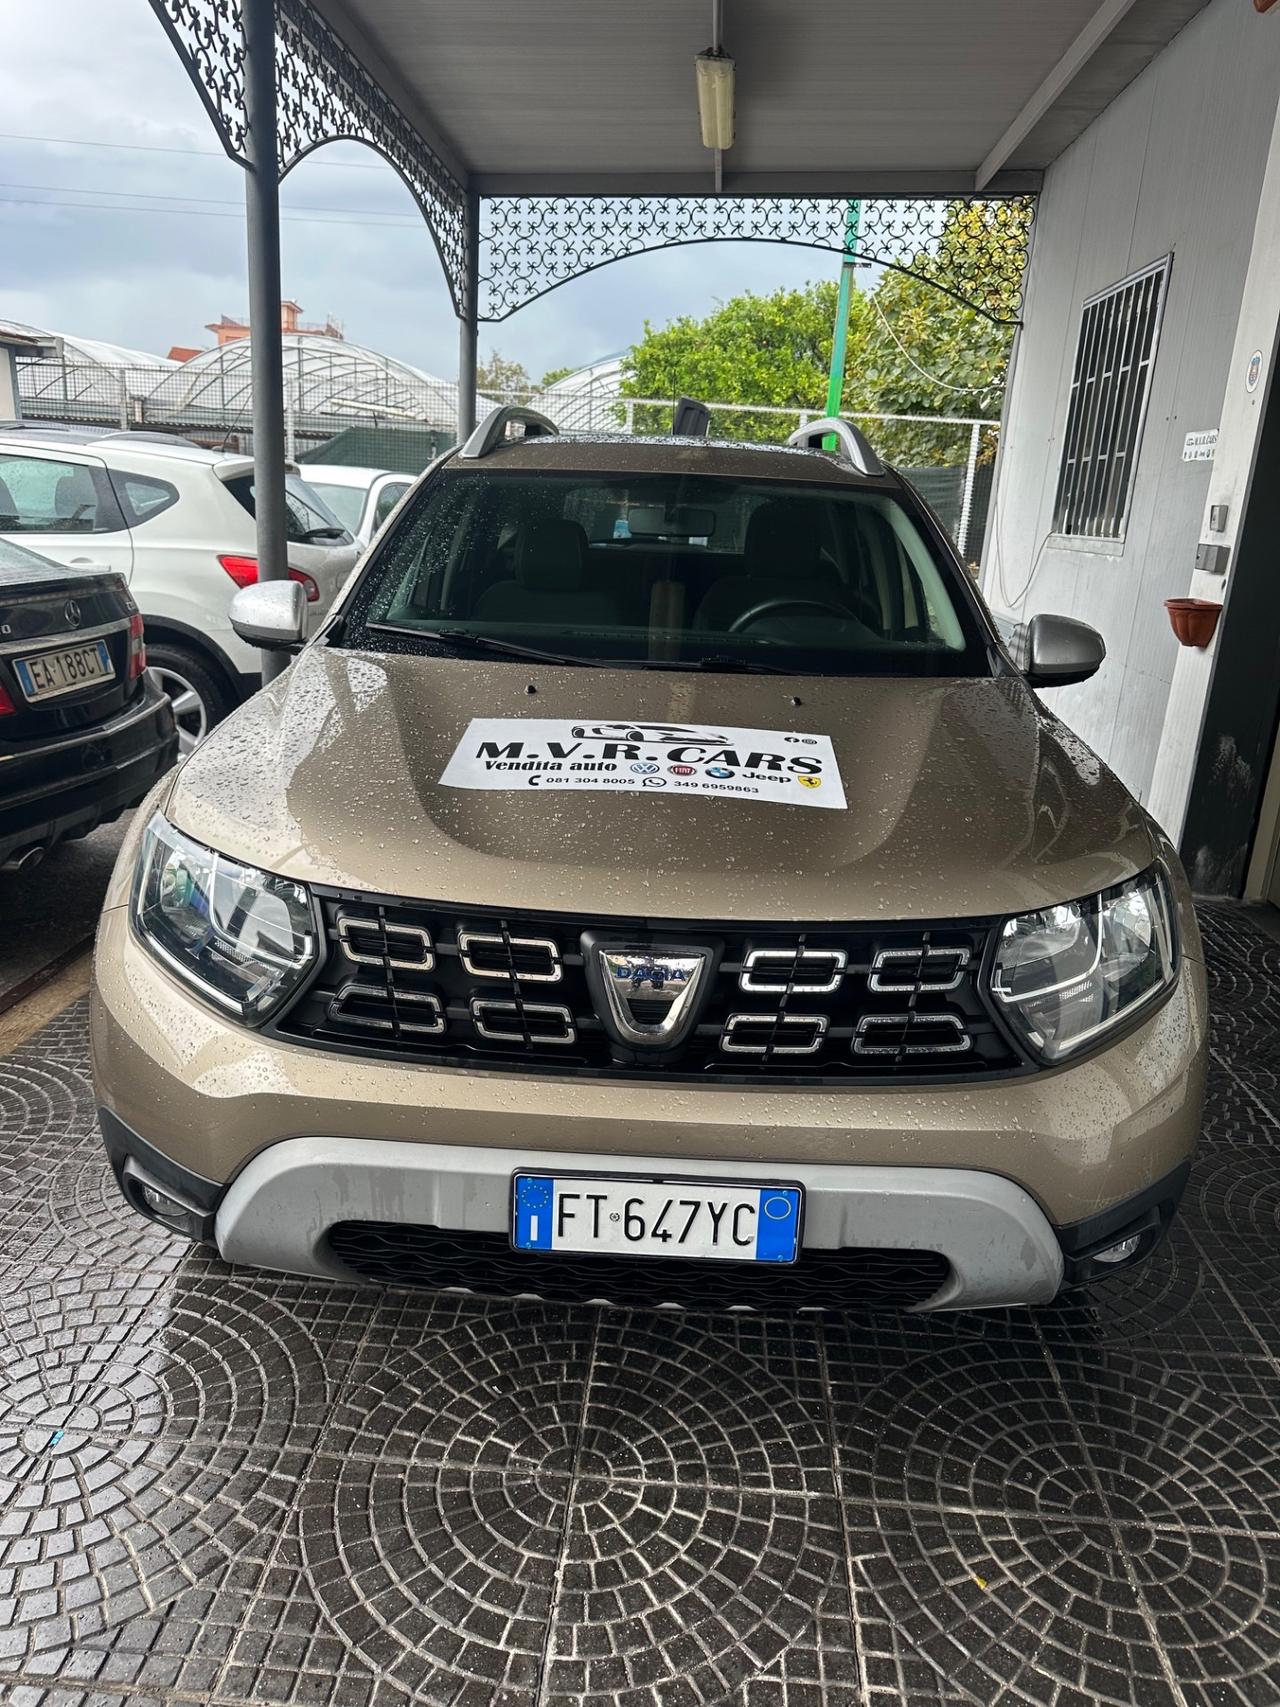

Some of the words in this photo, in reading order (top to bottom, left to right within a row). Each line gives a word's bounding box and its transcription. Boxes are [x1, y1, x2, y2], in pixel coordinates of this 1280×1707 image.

[485, 760, 563, 771] Vendita
[569, 761, 617, 772] auto
[742, 771, 792, 784] Jeep
[574, 777, 599, 785] 304
[602, 777, 636, 785] 8005
[673, 780, 699, 789] 349
[702, 783, 760, 794] 6959863
